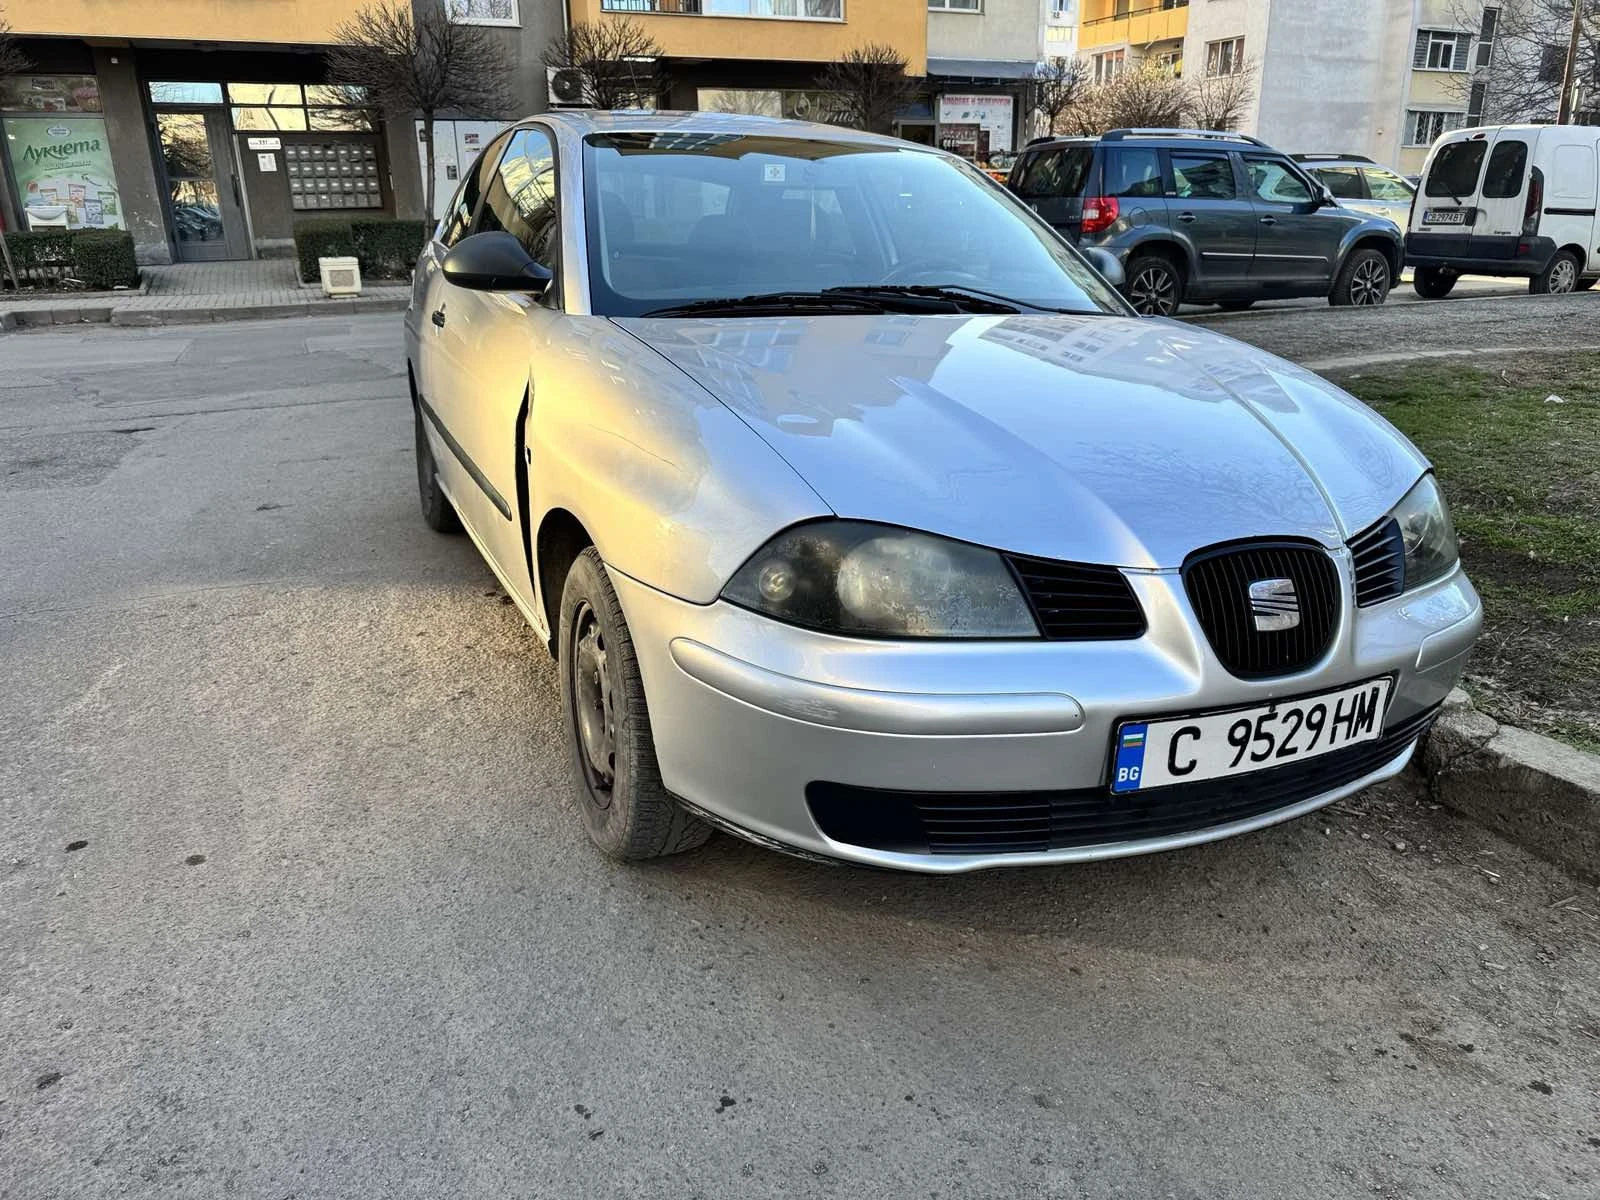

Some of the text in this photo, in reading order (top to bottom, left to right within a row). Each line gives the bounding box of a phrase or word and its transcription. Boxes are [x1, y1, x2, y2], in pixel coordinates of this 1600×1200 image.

[23, 139, 102, 165] Лукчета
[1167, 725, 1202, 777] C
[1117, 766, 1140, 782] BG
